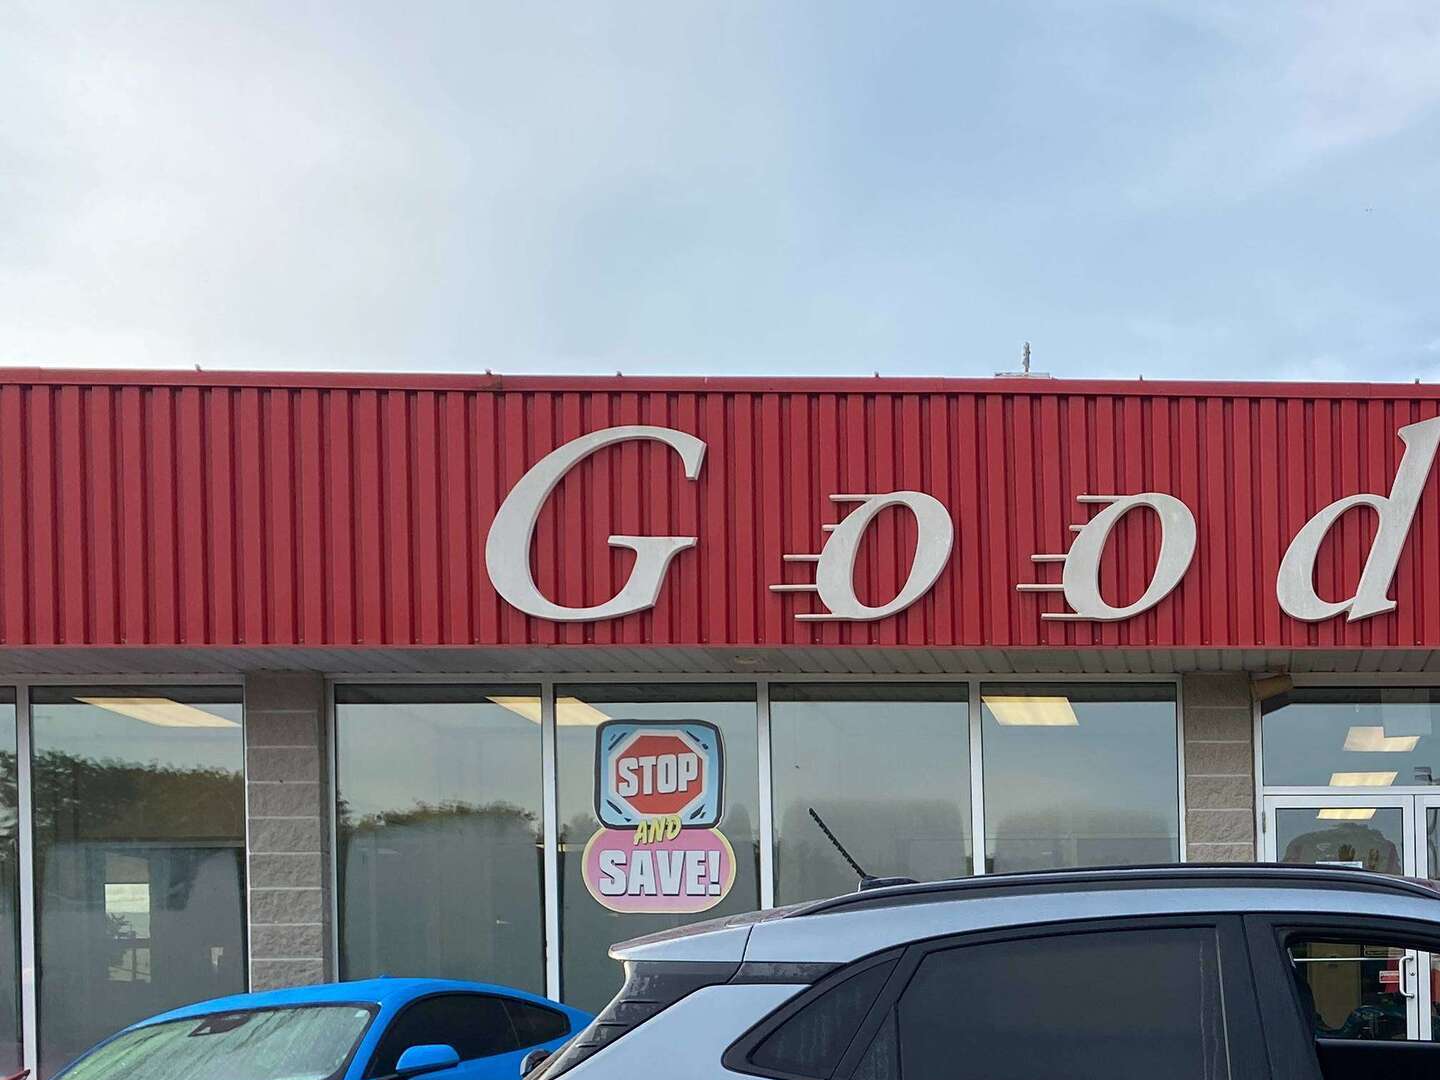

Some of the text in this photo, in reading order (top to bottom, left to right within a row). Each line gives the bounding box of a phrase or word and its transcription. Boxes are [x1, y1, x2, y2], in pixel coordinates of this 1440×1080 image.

[618, 752, 699, 798] STOP
[633, 814, 683, 846] AND
[599, 849, 722, 897] SAVE!
